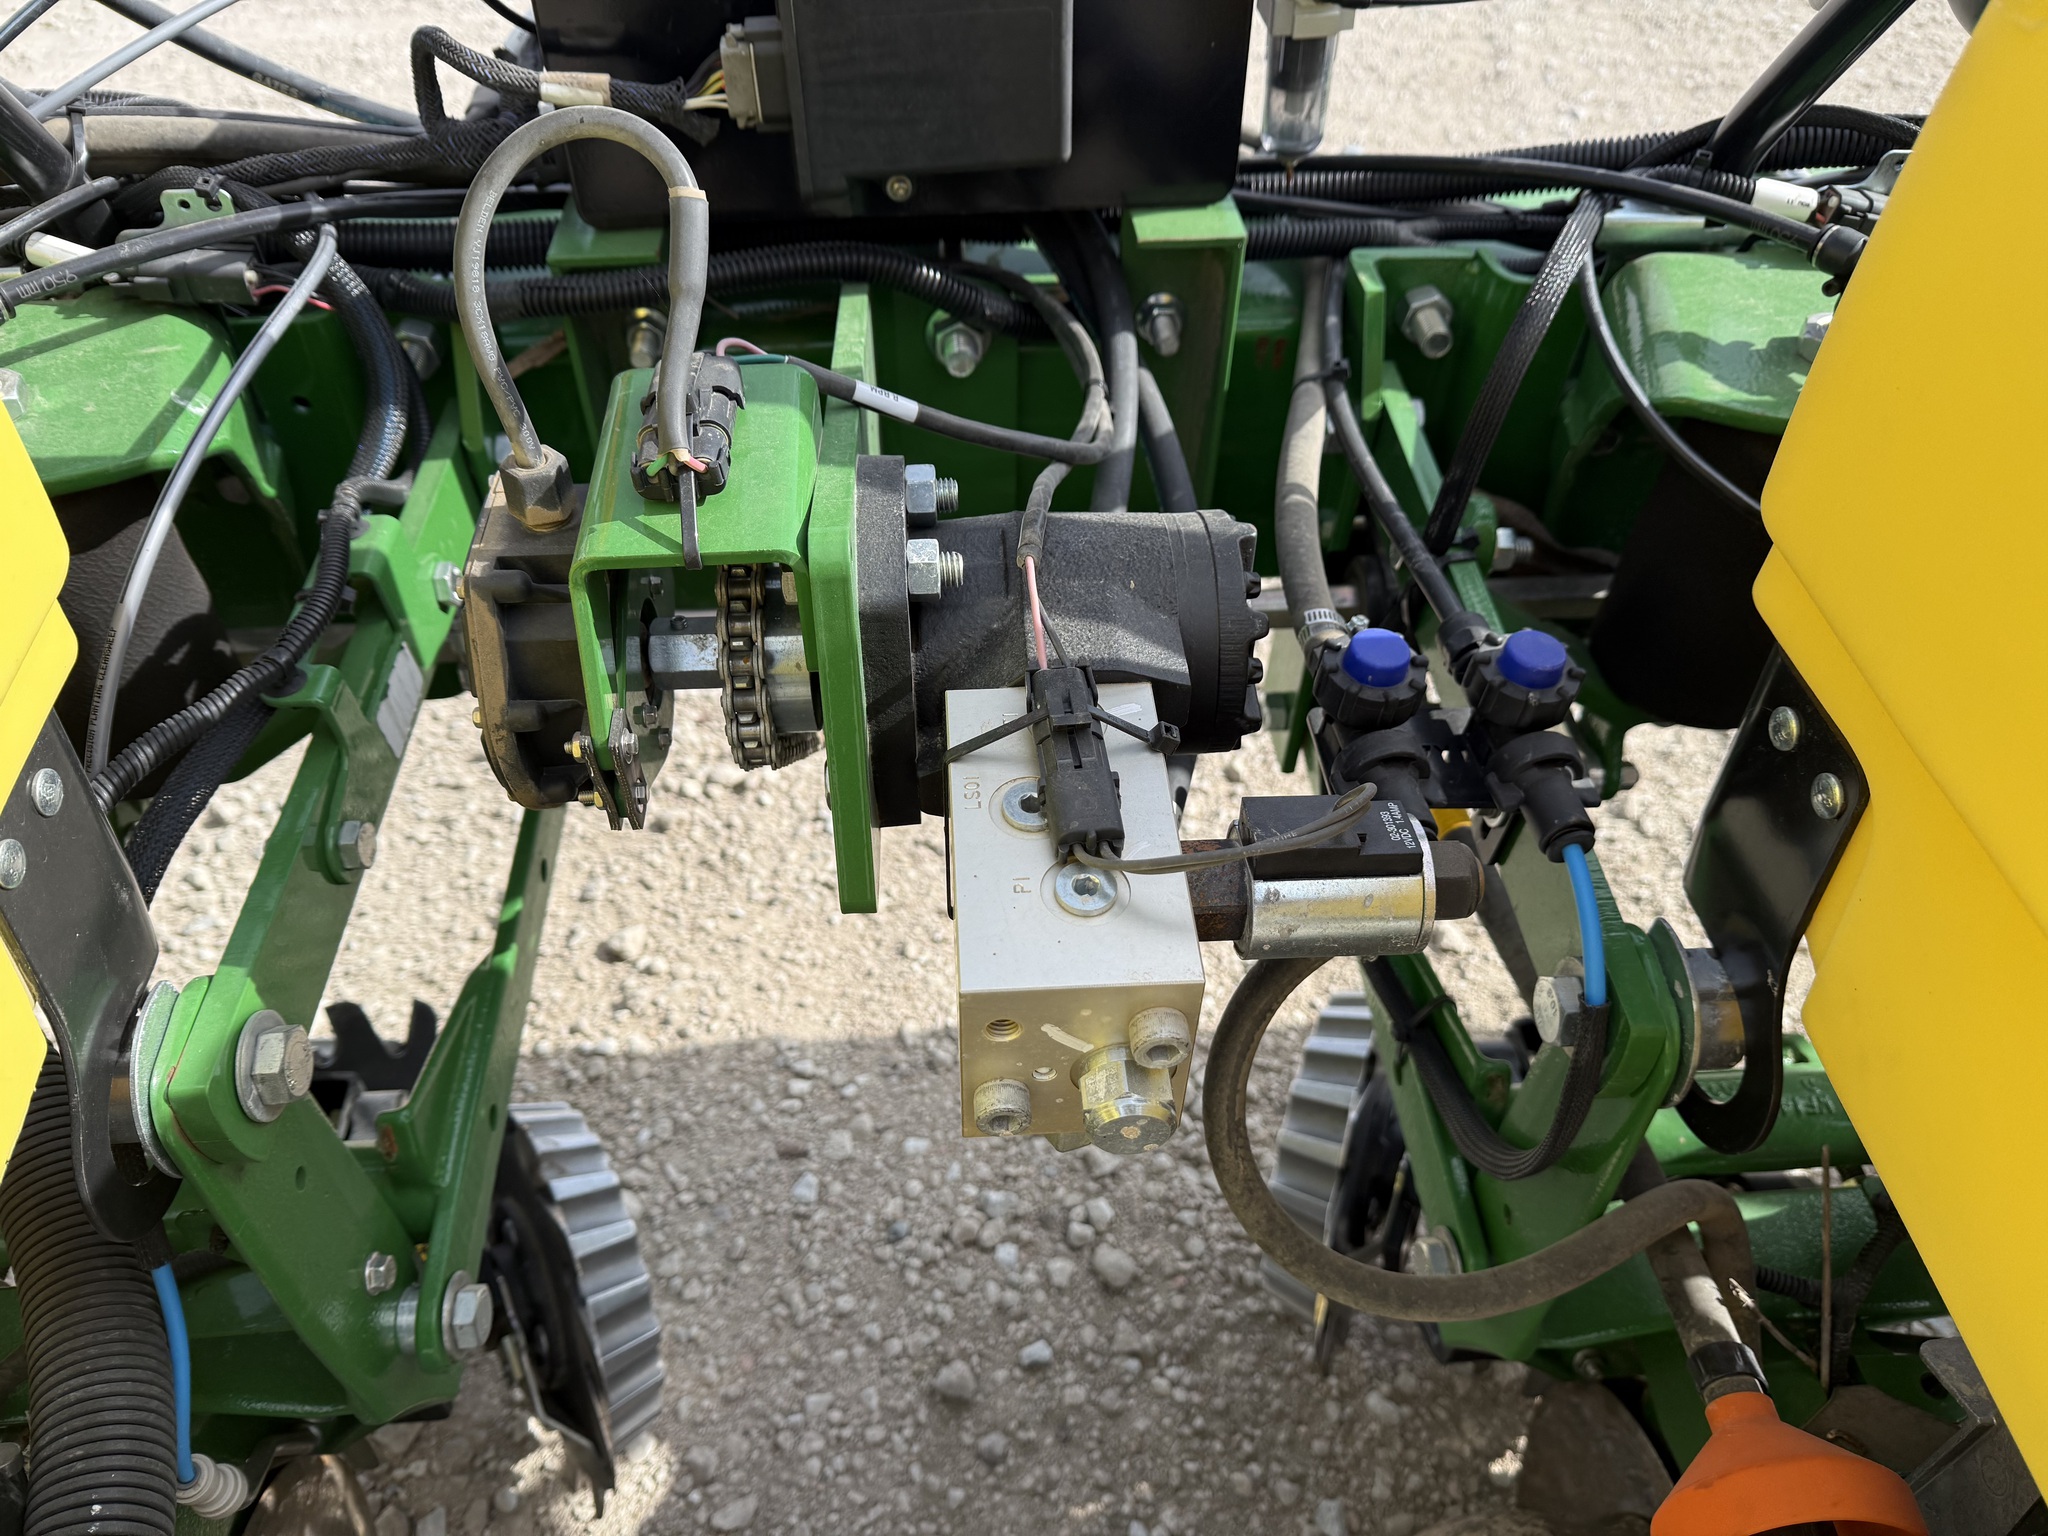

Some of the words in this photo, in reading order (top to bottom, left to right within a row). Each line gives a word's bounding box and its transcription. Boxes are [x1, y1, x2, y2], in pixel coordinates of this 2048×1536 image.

[42, 269, 78, 291] 950
[476, 190, 498, 233] BELDEN
[493, 366, 521, 417] PVC/PVC
[519, 423, 536, 450] 300V
[870, 386, 890, 398] RPM
[98, 627, 117, 681] CLEANSWEEP
[90, 682, 103, 726] PLANTING
[86, 729, 96, 774] PRECISION
[1380, 811, 1401, 841] 02-301393
[1388, 802, 1404, 823] 1.4AMP
[1399, 829, 1416, 848] 12VDC
